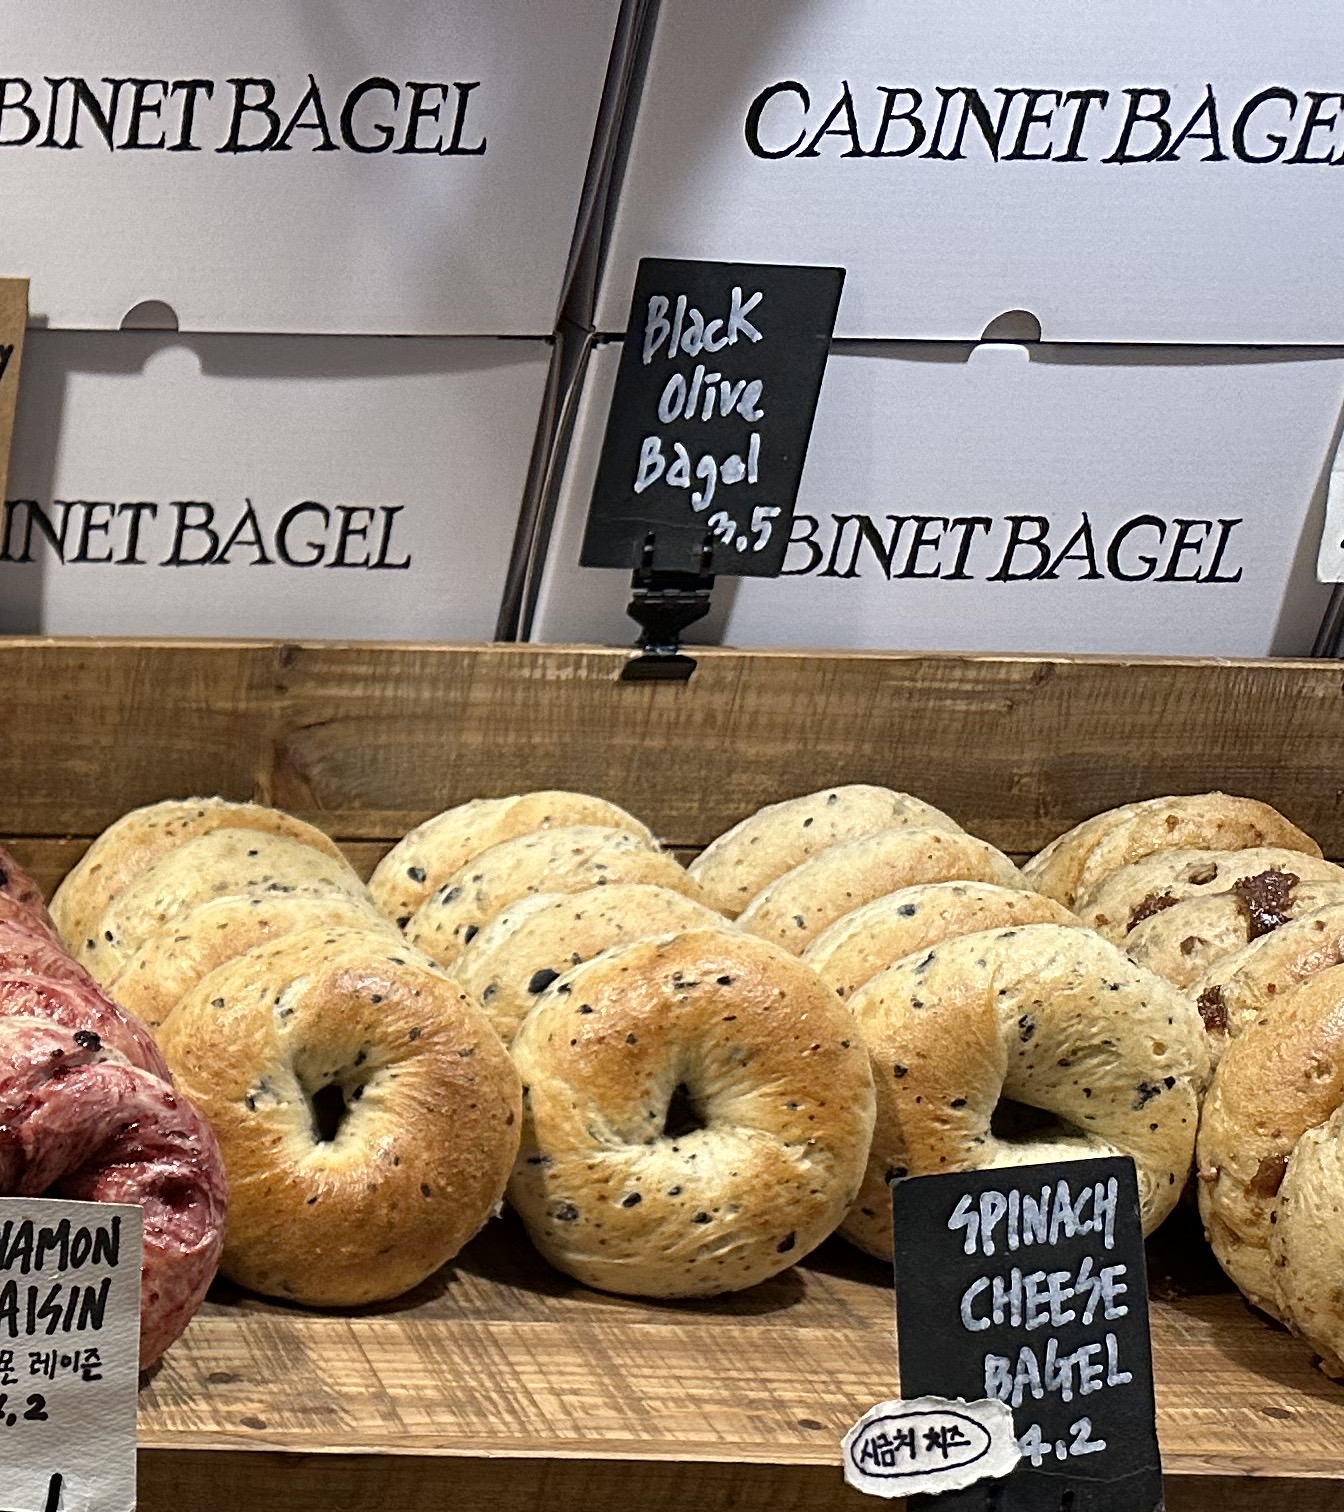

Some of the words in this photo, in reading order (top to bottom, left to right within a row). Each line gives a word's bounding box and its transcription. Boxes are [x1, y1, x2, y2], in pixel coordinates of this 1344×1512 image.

[214, 74, 486, 156] BAGEL
[744, 80, 1109, 163] CABINET
[1100, 83, 1344, 166] BAGE
[658, 364, 764, 424] Olive
[634, 432, 760, 512] Bagel
[160, 498, 411, 570] BAGEL
[708, 506, 781, 552] 3.5
[986, 512, 1243, 583] BAGEL
[948, 1177, 1118, 1255] SPINACH
[961, 1257, 1129, 1331] CHEESE
[28, 1348, 102, 1381] 레이즌
[984, 1334, 1133, 1407] BAGEL
[860, 1427, 916, 1467] 시금치
[922, 1425, 971, 1459] 치즈
[1019, 1417, 1106, 1466] 4.2
